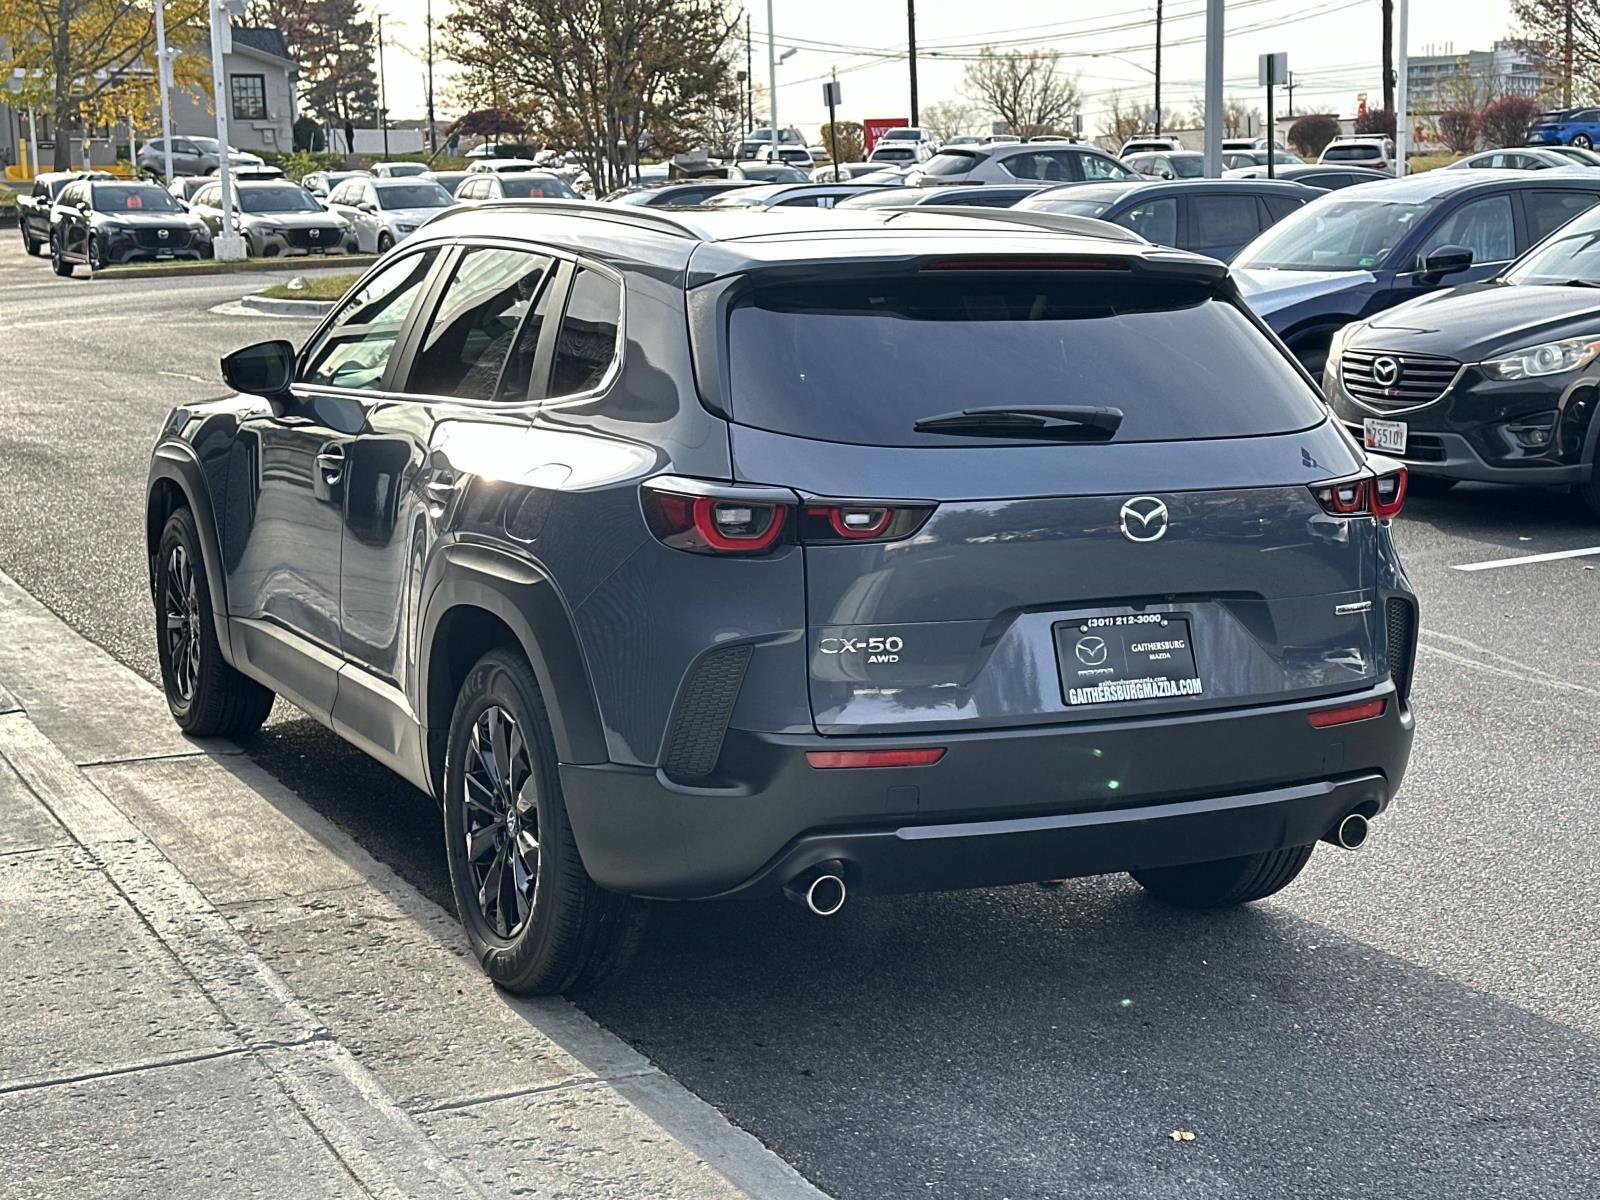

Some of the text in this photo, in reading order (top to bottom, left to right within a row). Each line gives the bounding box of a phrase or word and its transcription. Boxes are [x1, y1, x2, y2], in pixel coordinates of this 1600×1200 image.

[1087, 614, 1161, 627] (301) 212-3000
[820, 636, 903, 653] CX-50
[1131, 640, 1185, 652] GAITHERSBURG
[867, 655, 899, 664] AWD
[1149, 652, 1171, 660] MAZDA
[1069, 678, 1202, 704] GAITHERSBURGMAZDA.COM
